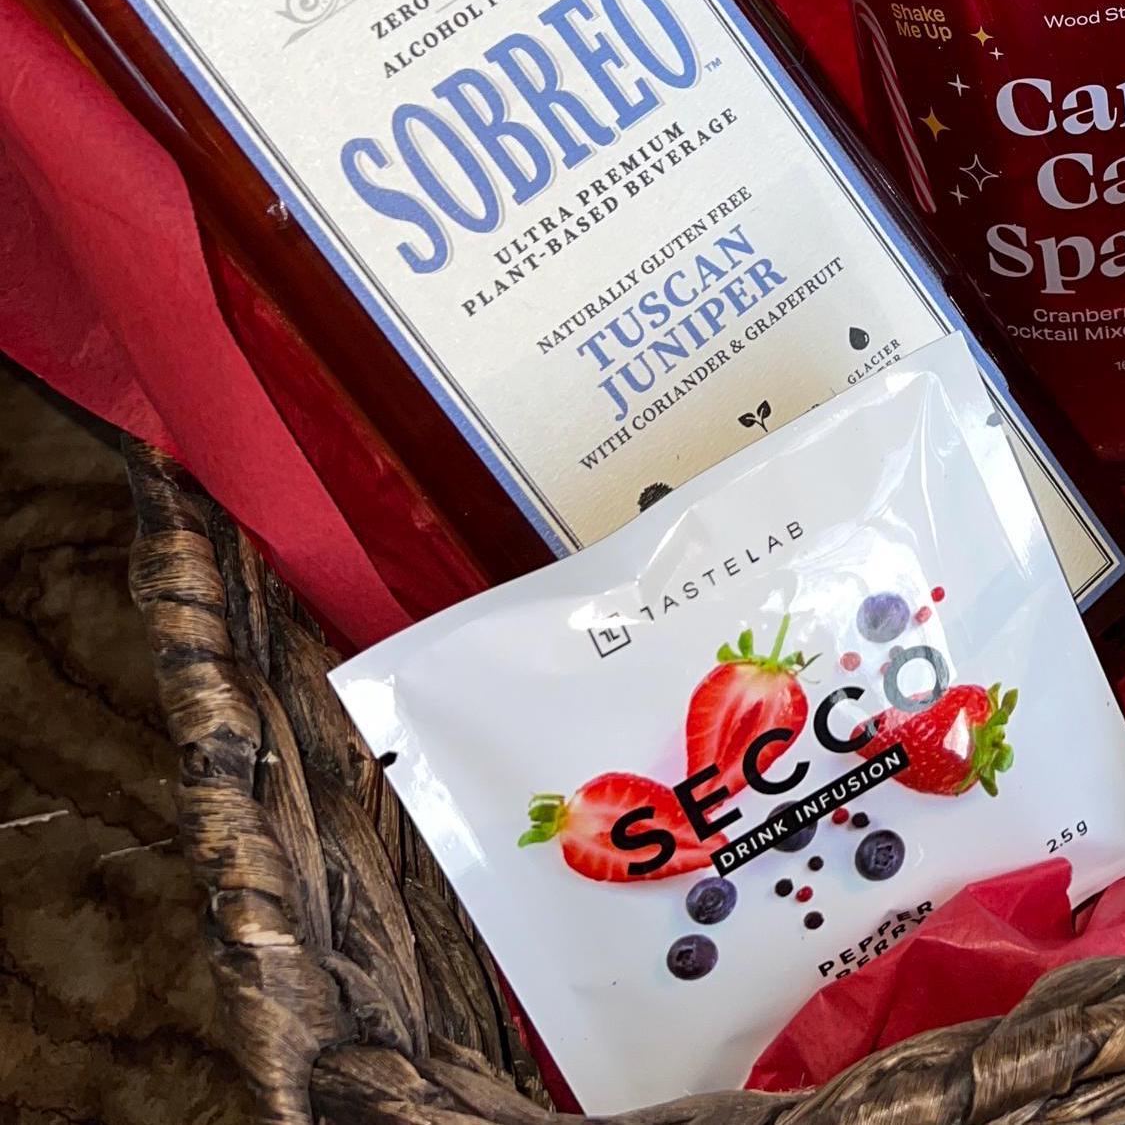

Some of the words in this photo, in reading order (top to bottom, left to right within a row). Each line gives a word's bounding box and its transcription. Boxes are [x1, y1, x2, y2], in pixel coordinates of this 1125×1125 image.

[383, 5, 483, 79] ALCOHOL
[892, 3, 945, 23] Shake
[897, 20, 924, 39] Me
[926, 23, 952, 42] Up
[1044, 11, 1100, 29] Wood
[462, 196, 619, 317] PLANT-BASED
[622, 108, 739, 198] BEVERAGE
[494, 208, 574, 266] ULTRA
[577, 121, 685, 205] PREMIUM
[536, 268, 640, 354] NATURALLY
[640, 219, 708, 276] GLUTEN
[708, 186, 753, 227] FREE
[577, 224, 757, 372] TUSCAN
[578, 427, 633, 472] WITH
[632, 348, 731, 431] CORIANDER
[730, 339, 745, 355] &
[744, 256, 846, 342] GRAPEFRUIT
[598, 257, 788, 422] JUNIPER
[847, 338, 901, 384] GLACIER
[1007, 325, 1079, 342] ocktail
[640, 520, 805, 623] TASTELAB
[610, 645, 950, 876] SECCO
[719, 819, 788, 869] DRINK
[794, 752, 900, 823] INFUSION
[818, 901, 933, 977] PEPPER
